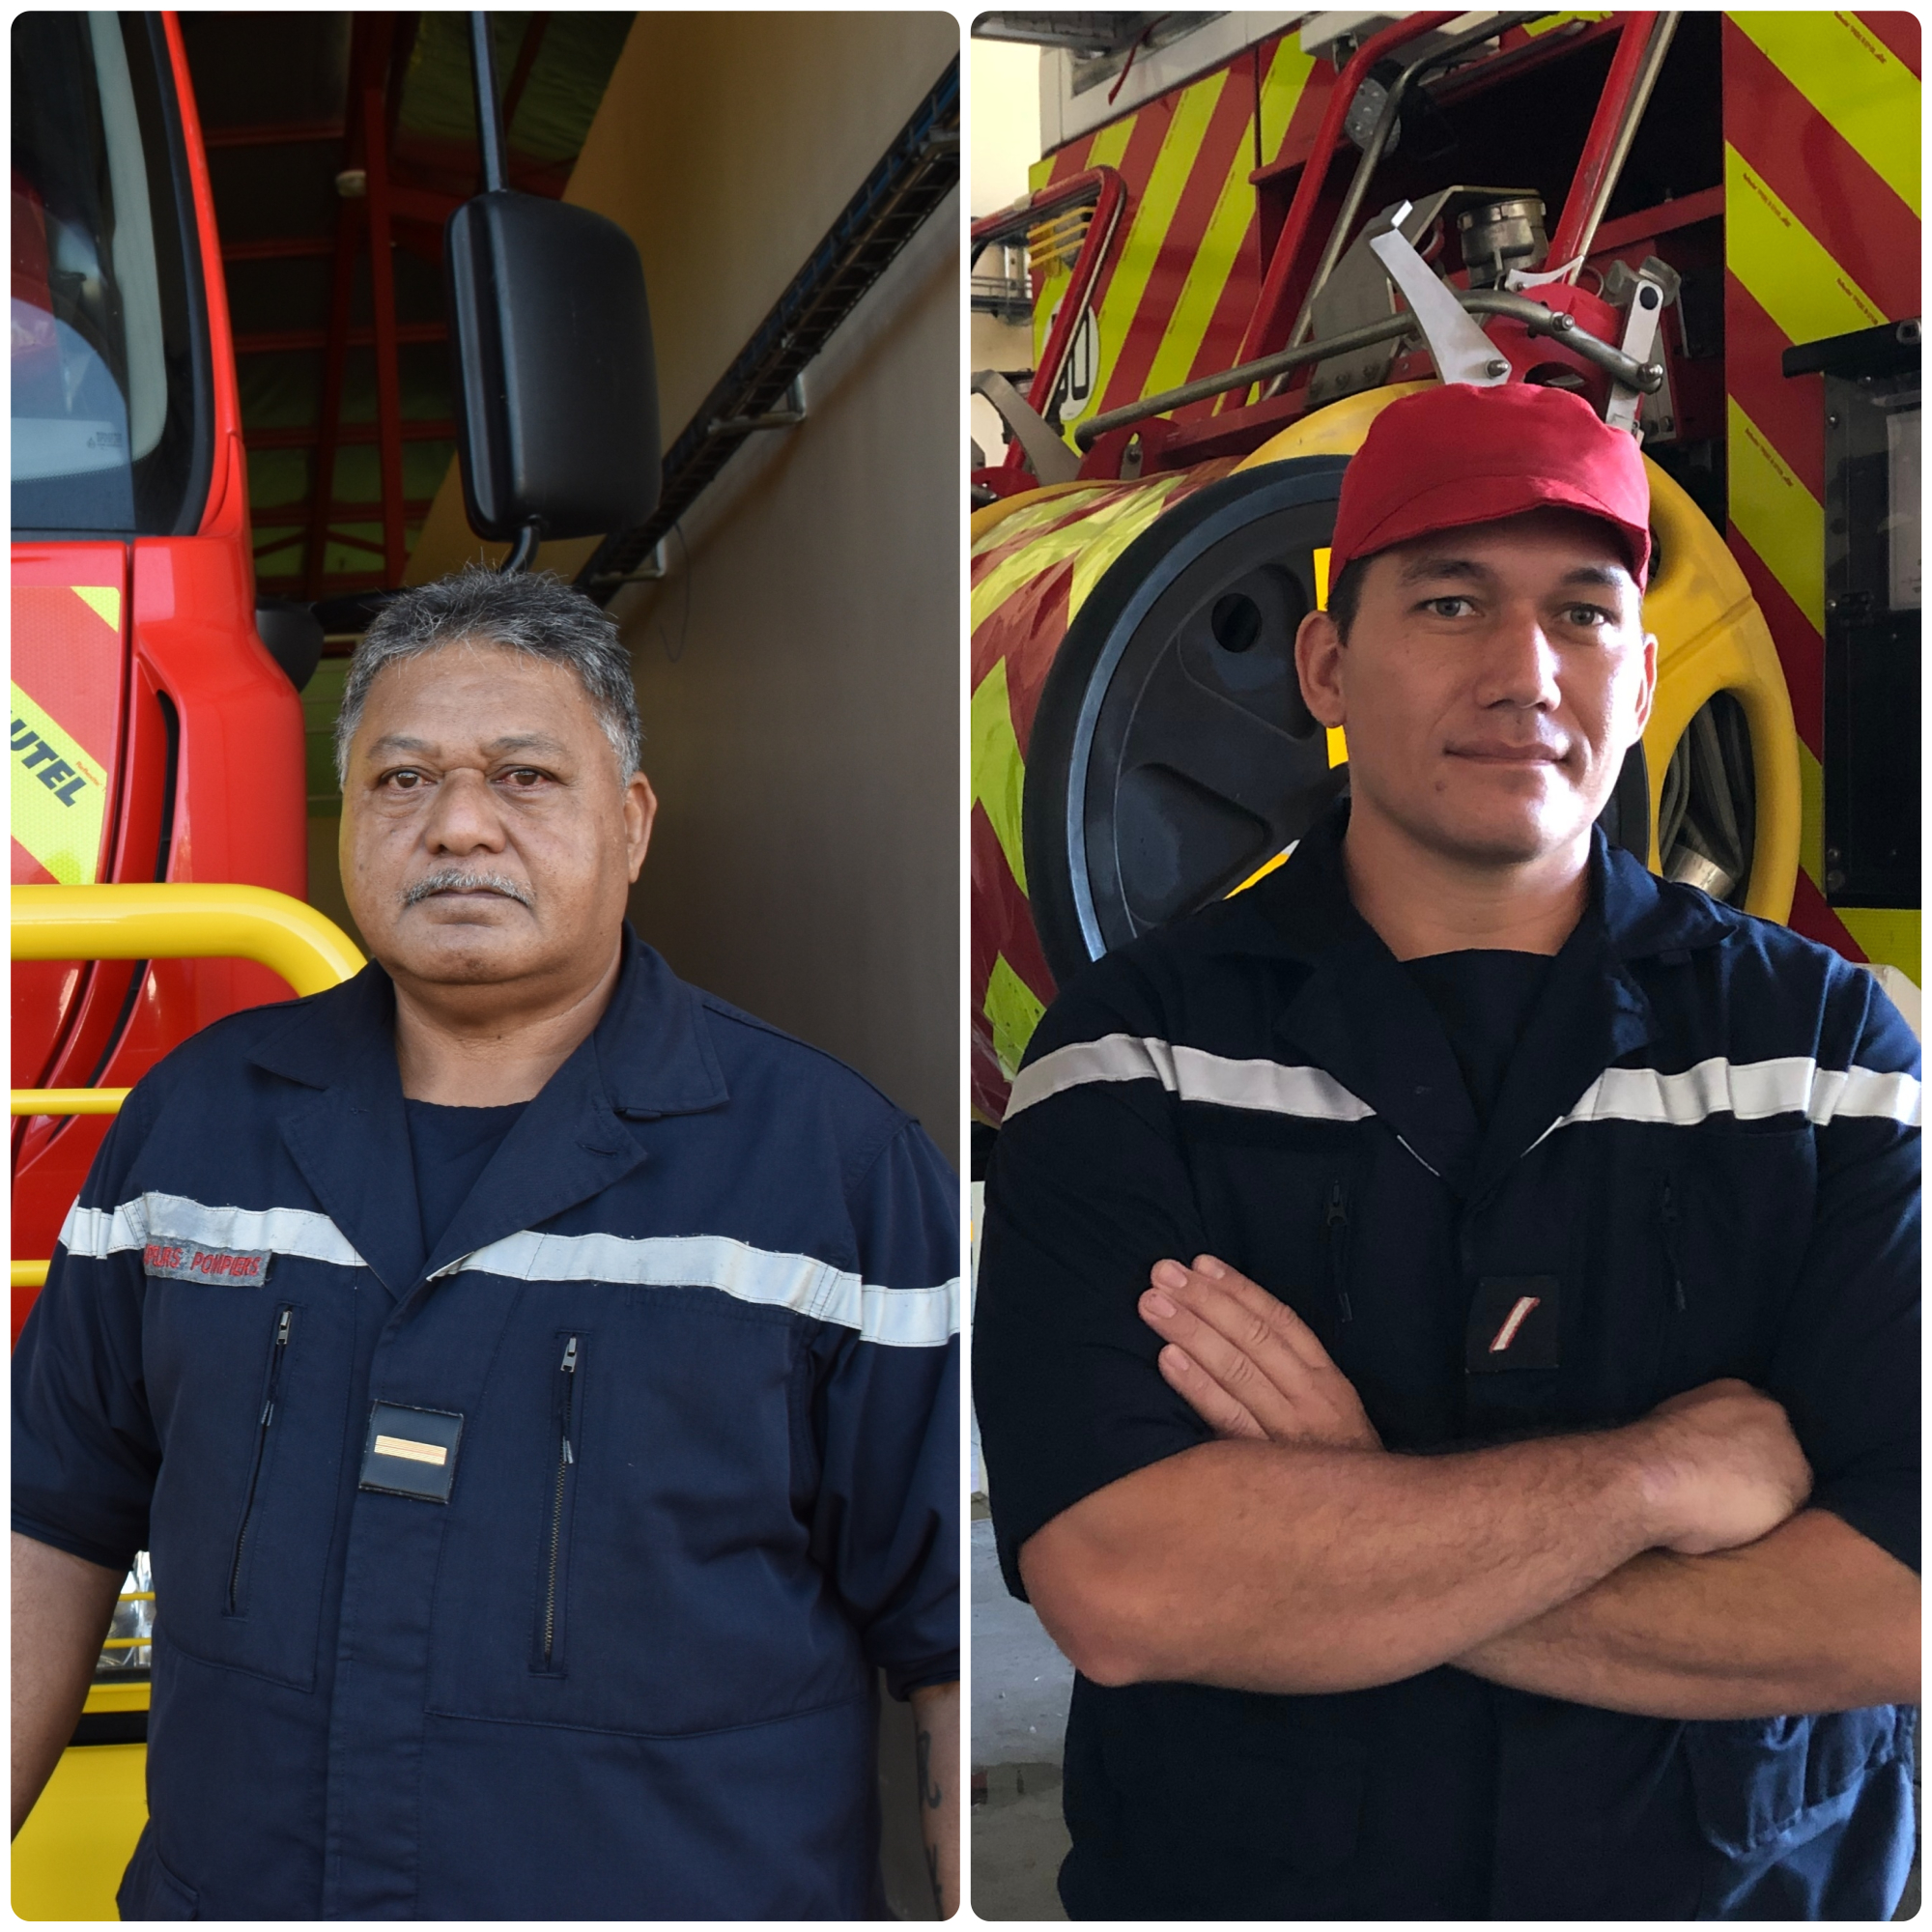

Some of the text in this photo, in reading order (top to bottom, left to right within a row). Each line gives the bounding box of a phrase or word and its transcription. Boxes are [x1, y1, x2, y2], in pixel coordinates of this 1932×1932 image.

[11, 710, 87, 808] UTEL
[143, 1242, 262, 1276] PEURS POMPIERS
